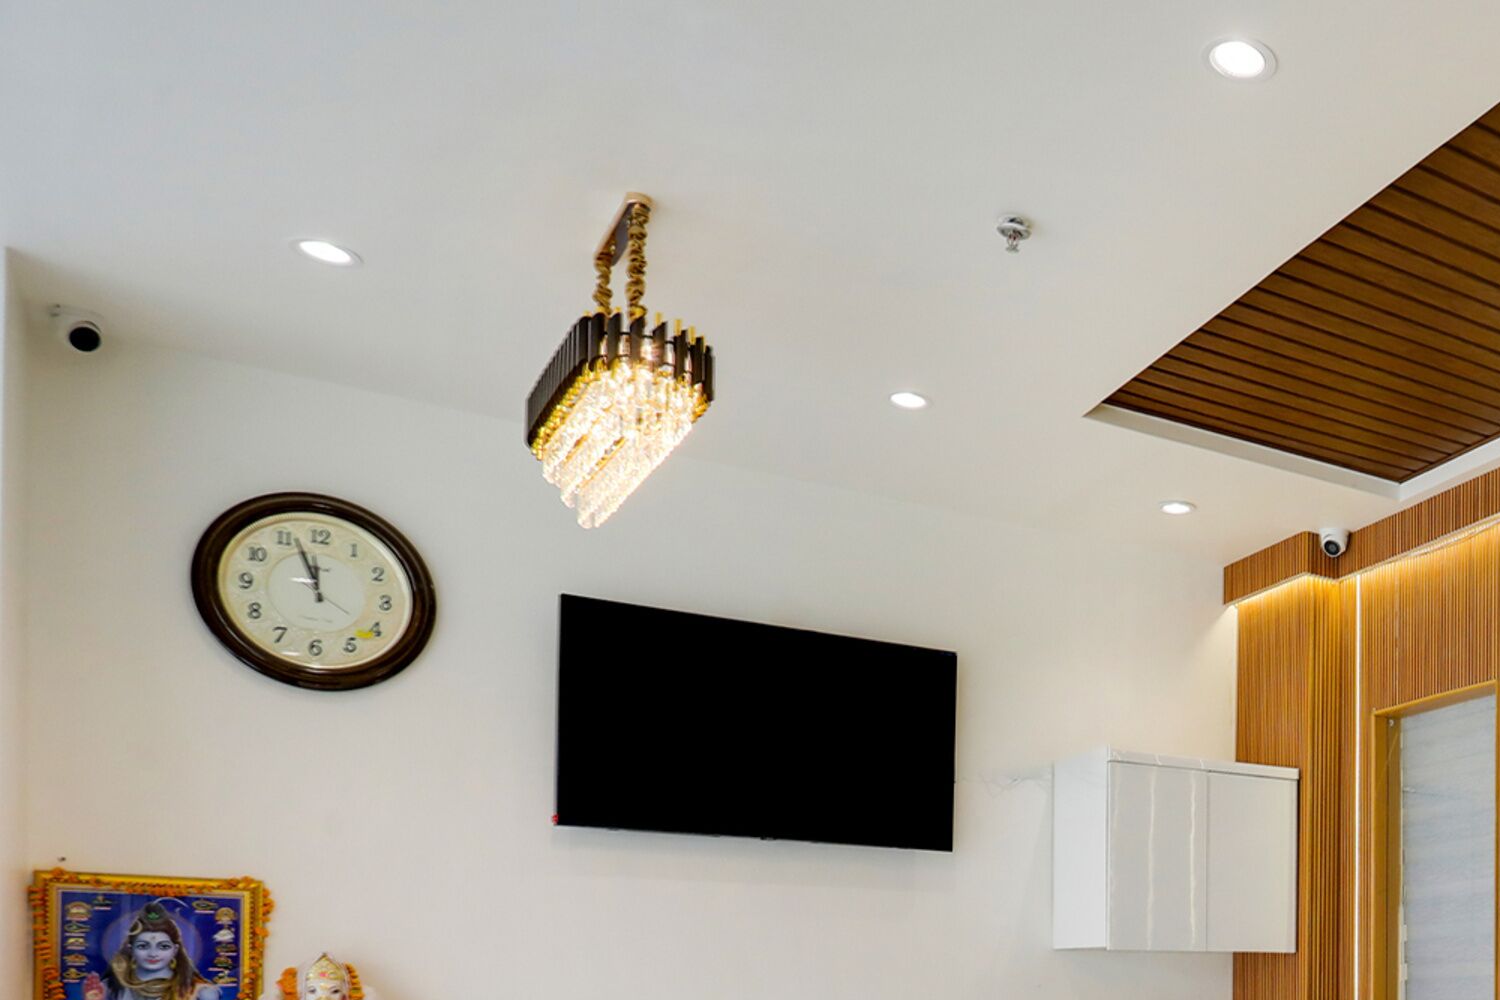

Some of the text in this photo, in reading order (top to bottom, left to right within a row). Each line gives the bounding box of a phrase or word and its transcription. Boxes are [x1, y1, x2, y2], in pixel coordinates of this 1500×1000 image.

[276, 530, 292, 546] 11
[310, 528, 331, 545] 12
[248, 547, 267, 562] 10
[350, 543, 358, 558] 1
[238, 572, 254, 589] 9
[371, 567, 385, 582] 2
[247, 602, 262, 619] 8
[379, 594, 392, 611] 3
[272, 626, 288, 644] 7
[369, 621, 382, 637] 4
[308, 639, 323, 656] 6
[343, 637, 357, 653] 5
